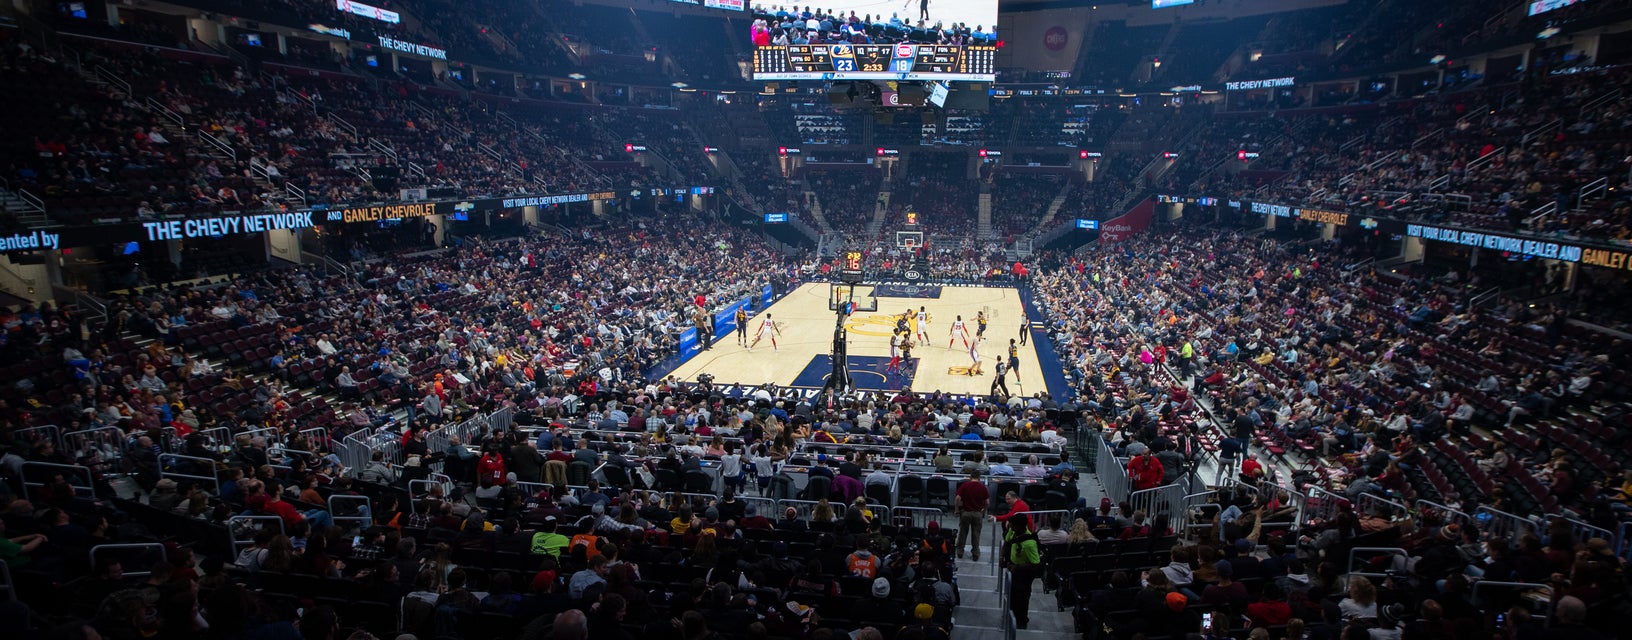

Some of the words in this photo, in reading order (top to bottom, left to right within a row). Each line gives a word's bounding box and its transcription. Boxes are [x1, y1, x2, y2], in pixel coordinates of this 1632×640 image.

[379, 36, 393, 49] THE
[393, 39, 415, 53] CHEVY
[416, 44, 447, 60] NETWORK
[837, 60, 853, 71] 23
[896, 60, 907, 71] 18
[1226, 82, 1239, 90] THE
[1240, 80, 1262, 89] CHEVY
[1263, 77, 1294, 88] NETWORK
[503, 197, 514, 208] VISIT
[515, 197, 526, 206] YOUR
[526, 197, 539, 206] LOCAL
[540, 196, 552, 205] CHEVY
[552, 195, 569, 204] NETWORK
[569, 194, 581, 202] DEALER
[327, 211, 342, 221] AND
[344, 207, 384, 223] GANLEY
[385, 203, 436, 219] CHEVROLET
[1259, 203, 1270, 214] CHEVY
[1270, 205, 1290, 218] NETWORK
[1300, 208, 1319, 221] GANLEY
[1318, 211, 1348, 226] CHEVROLET
[143, 221, 183, 241] THE
[185, 216, 240, 238] CHEVY
[243, 211, 314, 233] NETWORK
[1102, 224, 1131, 233] KeyBank
[41, 230, 59, 249] by
[1407, 224, 1422, 236] VISIT
[1422, 226, 1439, 240] YOUR
[1439, 228, 1459, 243] LOCAL
[1460, 231, 1484, 246] CHEVY
[1484, 234, 1523, 253] NETWORK
[1523, 240, 1559, 258] DEALER
[1558, 245, 1582, 262] AND
[1582, 248, 1627, 268] GANLEY
[849, 260, 859, 269] 16
